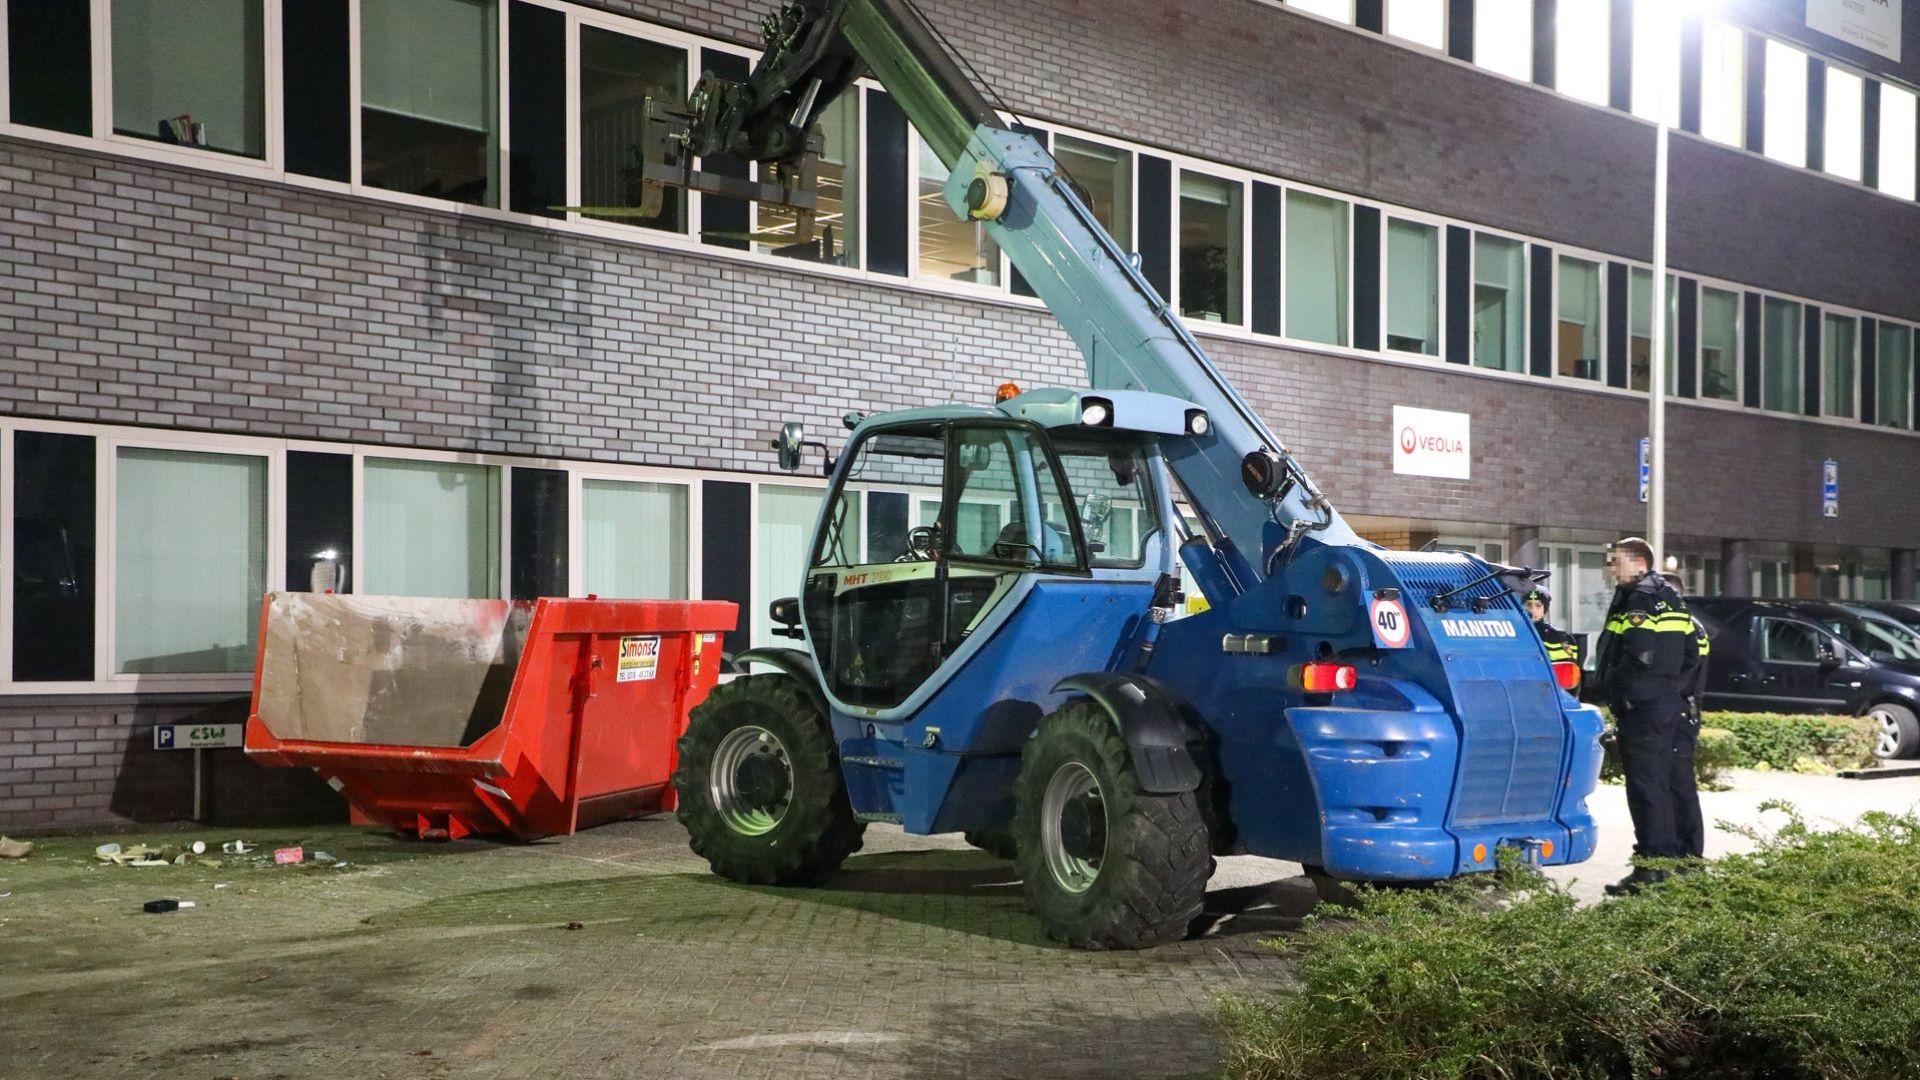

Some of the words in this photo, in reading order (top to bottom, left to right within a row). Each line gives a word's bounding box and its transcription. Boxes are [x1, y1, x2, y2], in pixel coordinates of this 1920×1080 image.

[1418, 434, 1464, 454] VEOLIA
[843, 572, 868, 586] MHT
[1377, 610, 1397, 631] 40
[1440, 619, 1517, 638] MANITOU
[160, 729, 172, 744] P
